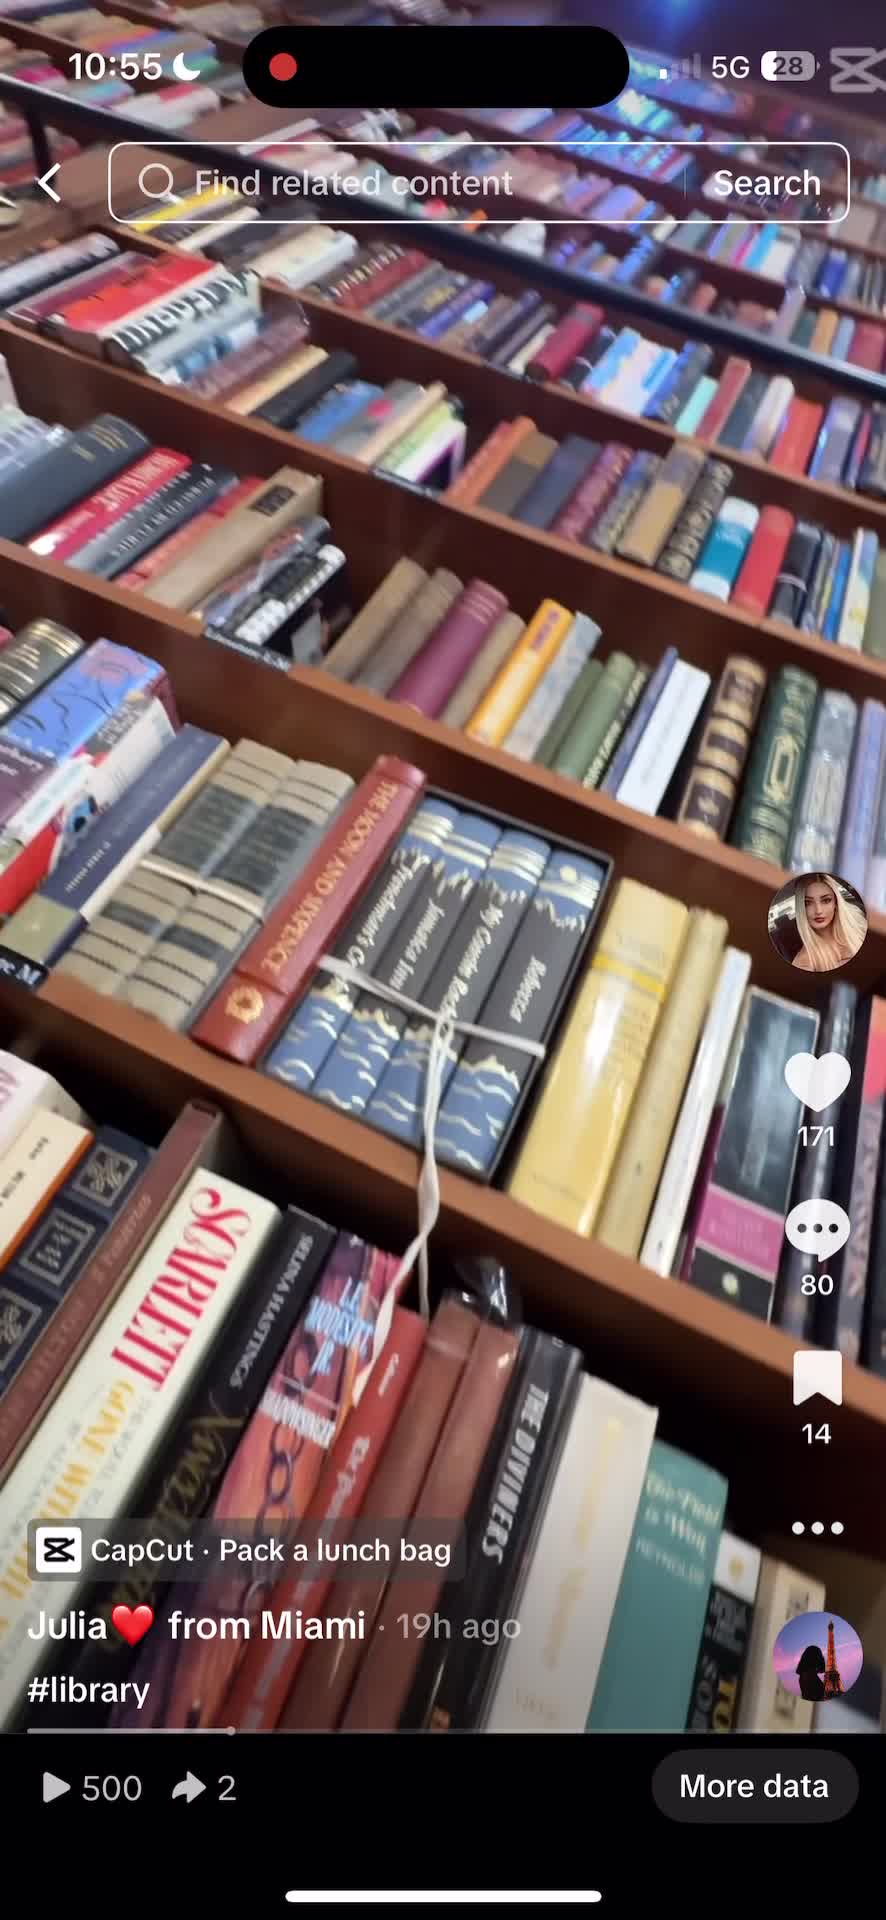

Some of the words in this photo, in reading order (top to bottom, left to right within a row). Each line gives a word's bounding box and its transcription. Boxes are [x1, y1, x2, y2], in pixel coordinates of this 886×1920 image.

[404, 898, 446, 963] Jamaica
[509, 955, 547, 1024] Rebecca
[111, 1187, 252, 1391] SCARLETT
[520, 1383, 550, 1434] THE
[482, 1427, 538, 1566] DIVINERS
